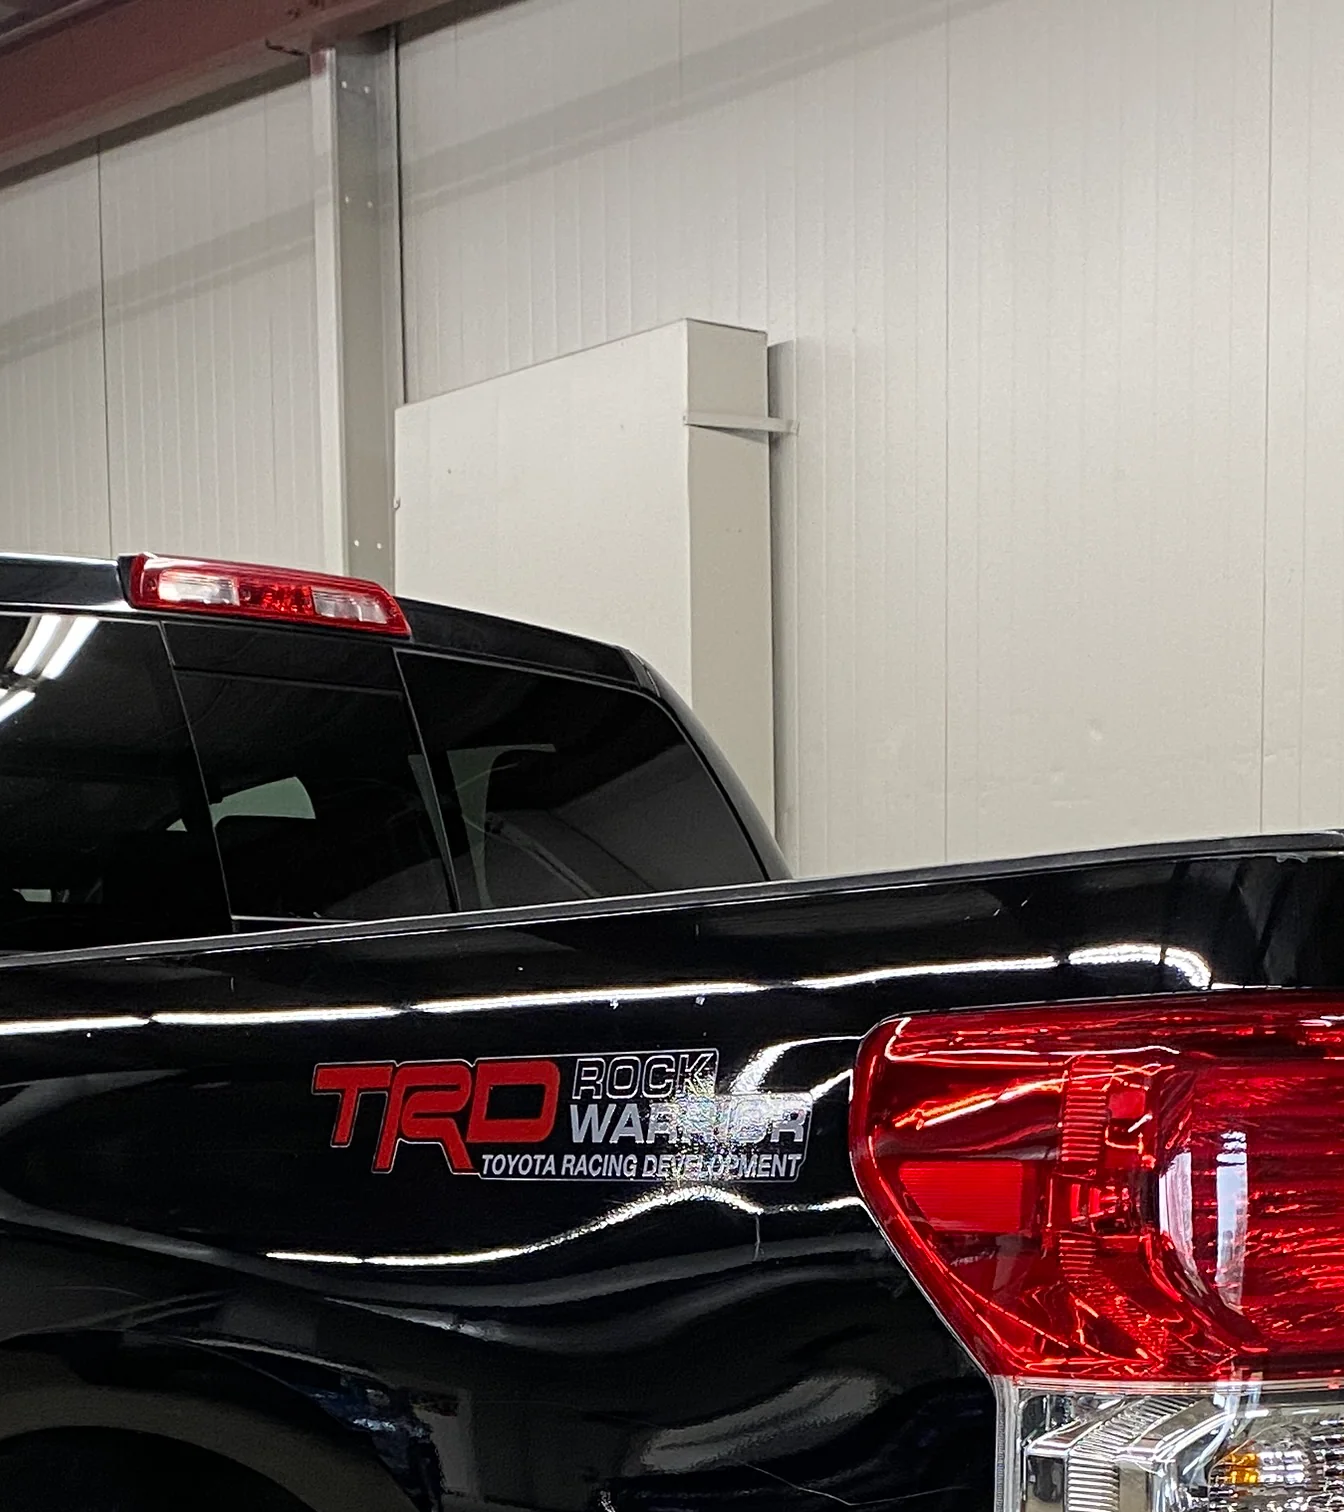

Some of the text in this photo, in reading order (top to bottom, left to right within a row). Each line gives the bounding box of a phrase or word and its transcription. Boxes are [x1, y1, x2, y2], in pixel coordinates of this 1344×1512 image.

[572, 1053, 714, 1100] ROCK
[313, 1061, 561, 1173] TRD
[481, 1153, 556, 1176] TOYOTA
[560, 1153, 638, 1177] RACING
